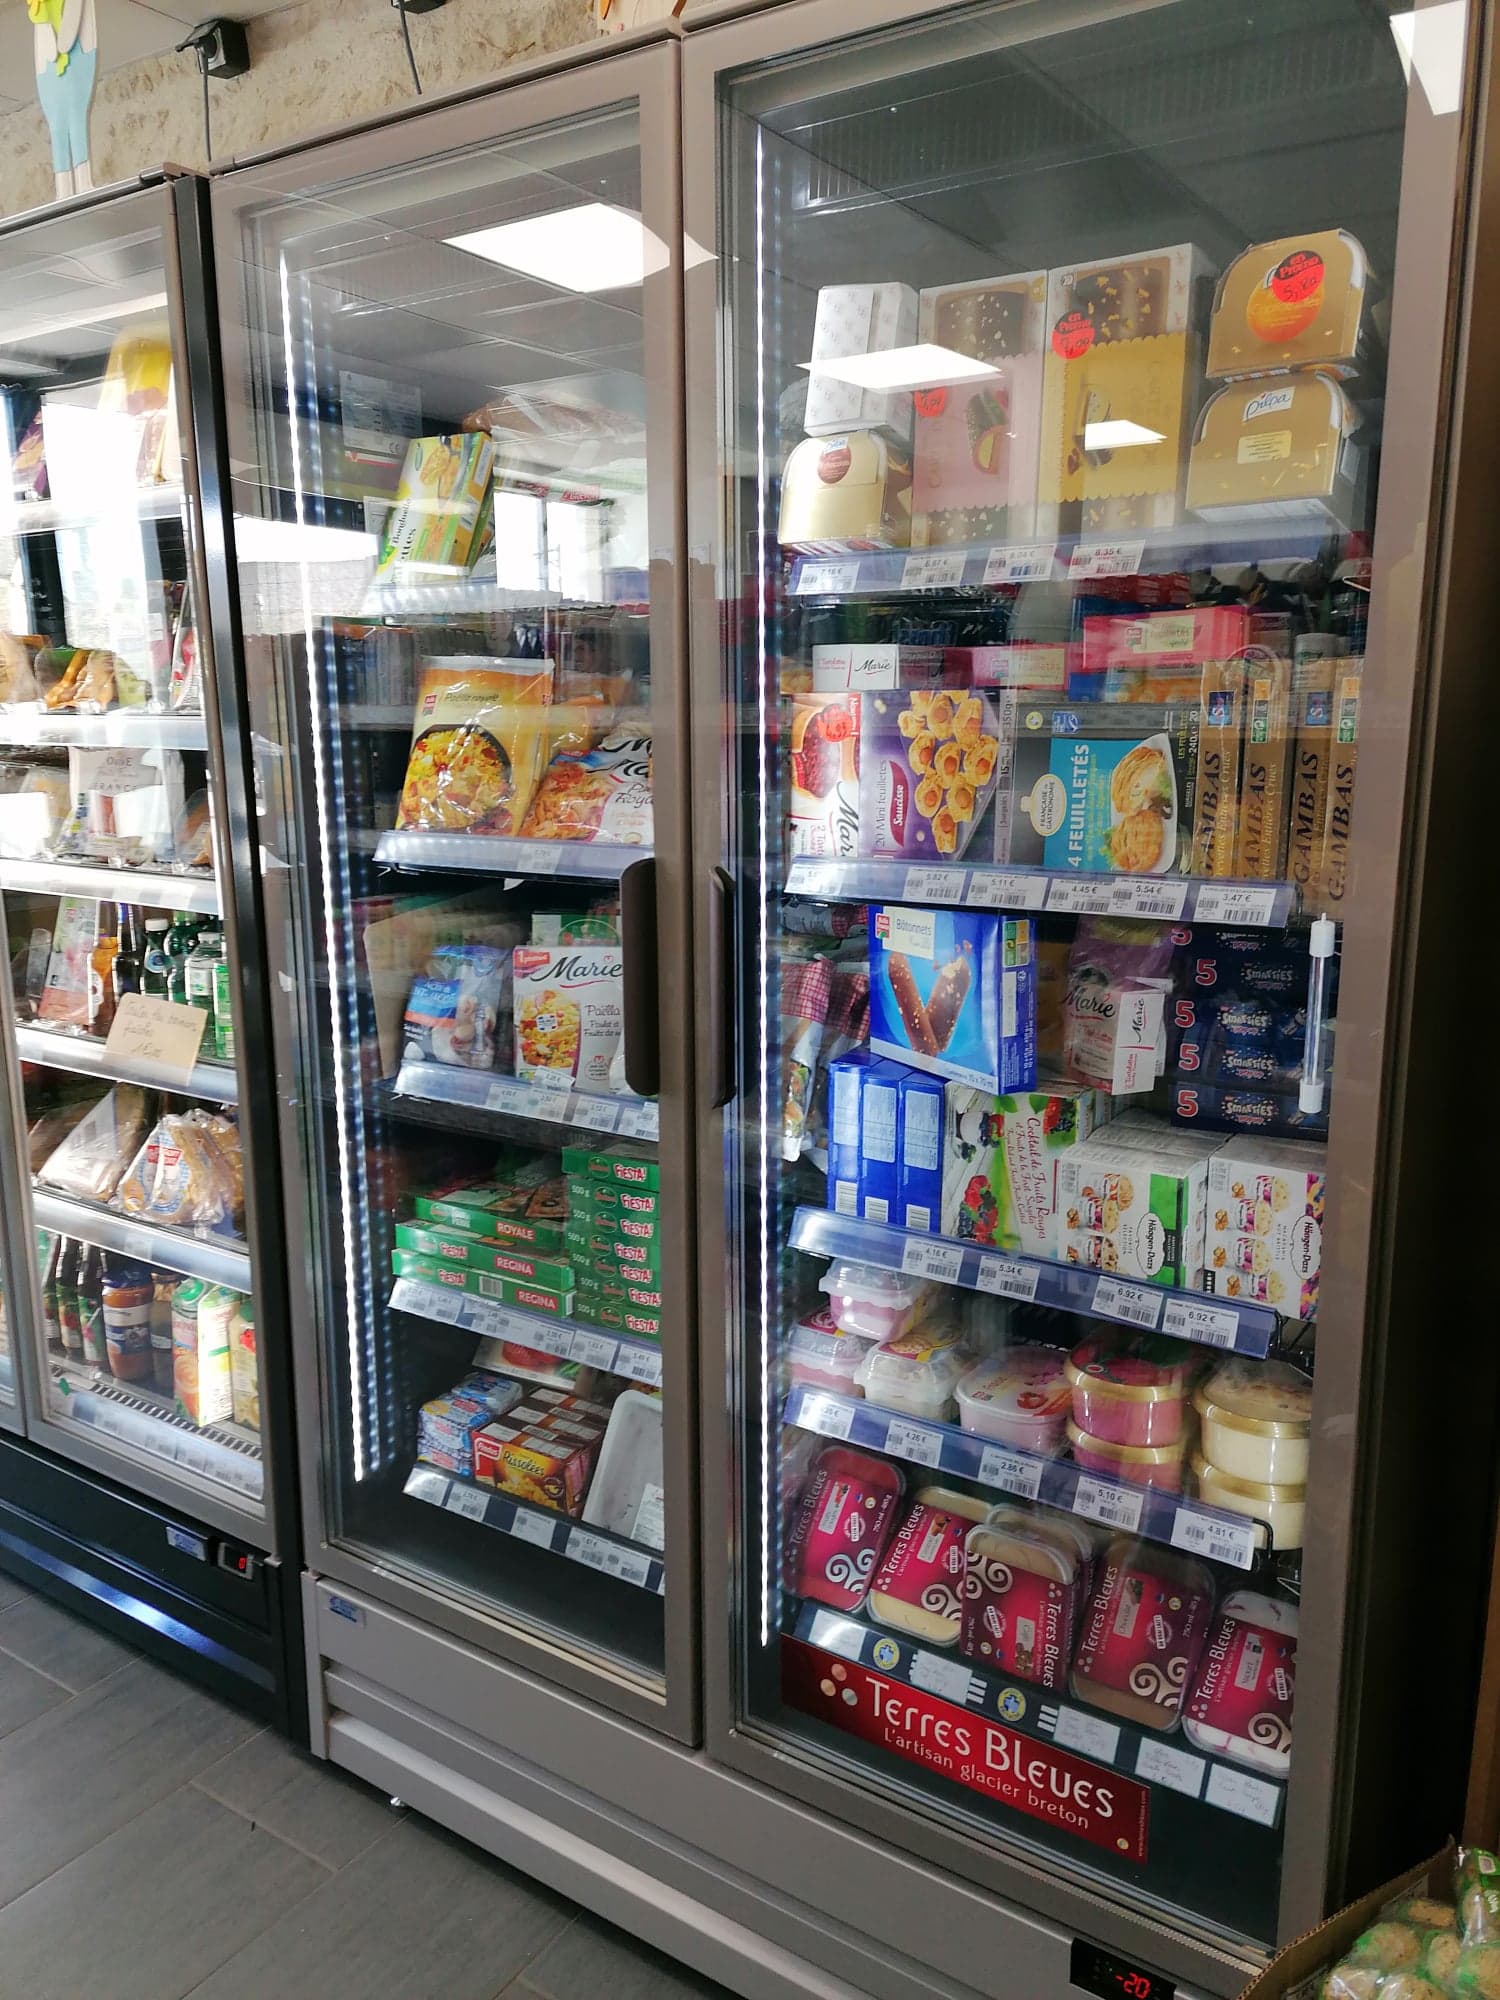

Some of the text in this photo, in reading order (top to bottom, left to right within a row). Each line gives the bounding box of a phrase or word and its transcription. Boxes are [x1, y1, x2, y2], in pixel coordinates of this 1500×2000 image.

[854, 657, 892, 672] Marie
[893, 784, 904, 826] Saucisse
[1068, 743, 1090, 868] 4 FEUILLETÉS
[1293, 751, 1318, 885] GAMBAS
[1243, 762, 1266, 878] AMBAS
[1328, 763, 1353, 902] GAMBAS
[530, 954, 624, 982] Marie
[1195, 958, 1218, 986] 5
[1060, 985, 1116, 1018] Marie
[1175, 1000, 1195, 1029] 5
[1131, 997, 1145, 1044] Marie
[1179, 1043, 1200, 1071] 5
[1177, 1089, 1199, 1118] 5
[571, 1184, 584, 1195] 500
[573, 1209, 585, 1219] 500
[1035, 1207, 1050, 1240] Rouges
[497, 1222, 534, 1240] ROYALE
[567, 1230, 579, 1242] 500
[572, 1253, 584, 1264] 500
[1301, 1221, 1314, 1274] Häagen-Dazs
[496, 1257, 533, 1275] REGINA
[519, 1290, 556, 1309] REGINA
[577, 1303, 590, 1314] 500
[1117, 1288, 1137, 1300] 6.92
[1188, 1311, 1208, 1323] 6.92
[881, 1503, 925, 1575] Terres Bleues
[1081, 1565, 1119, 1653] Terres Bleues
[1042, 1602, 1063, 1688] Terres Bleues
[1195, 1618, 1236, 1699] Terres Bleues
[865, 1676, 971, 1756] Terres
[985, 1727, 1115, 1819] Bleues
[884, 1726, 1090, 1830] L'artisan glacier breton
